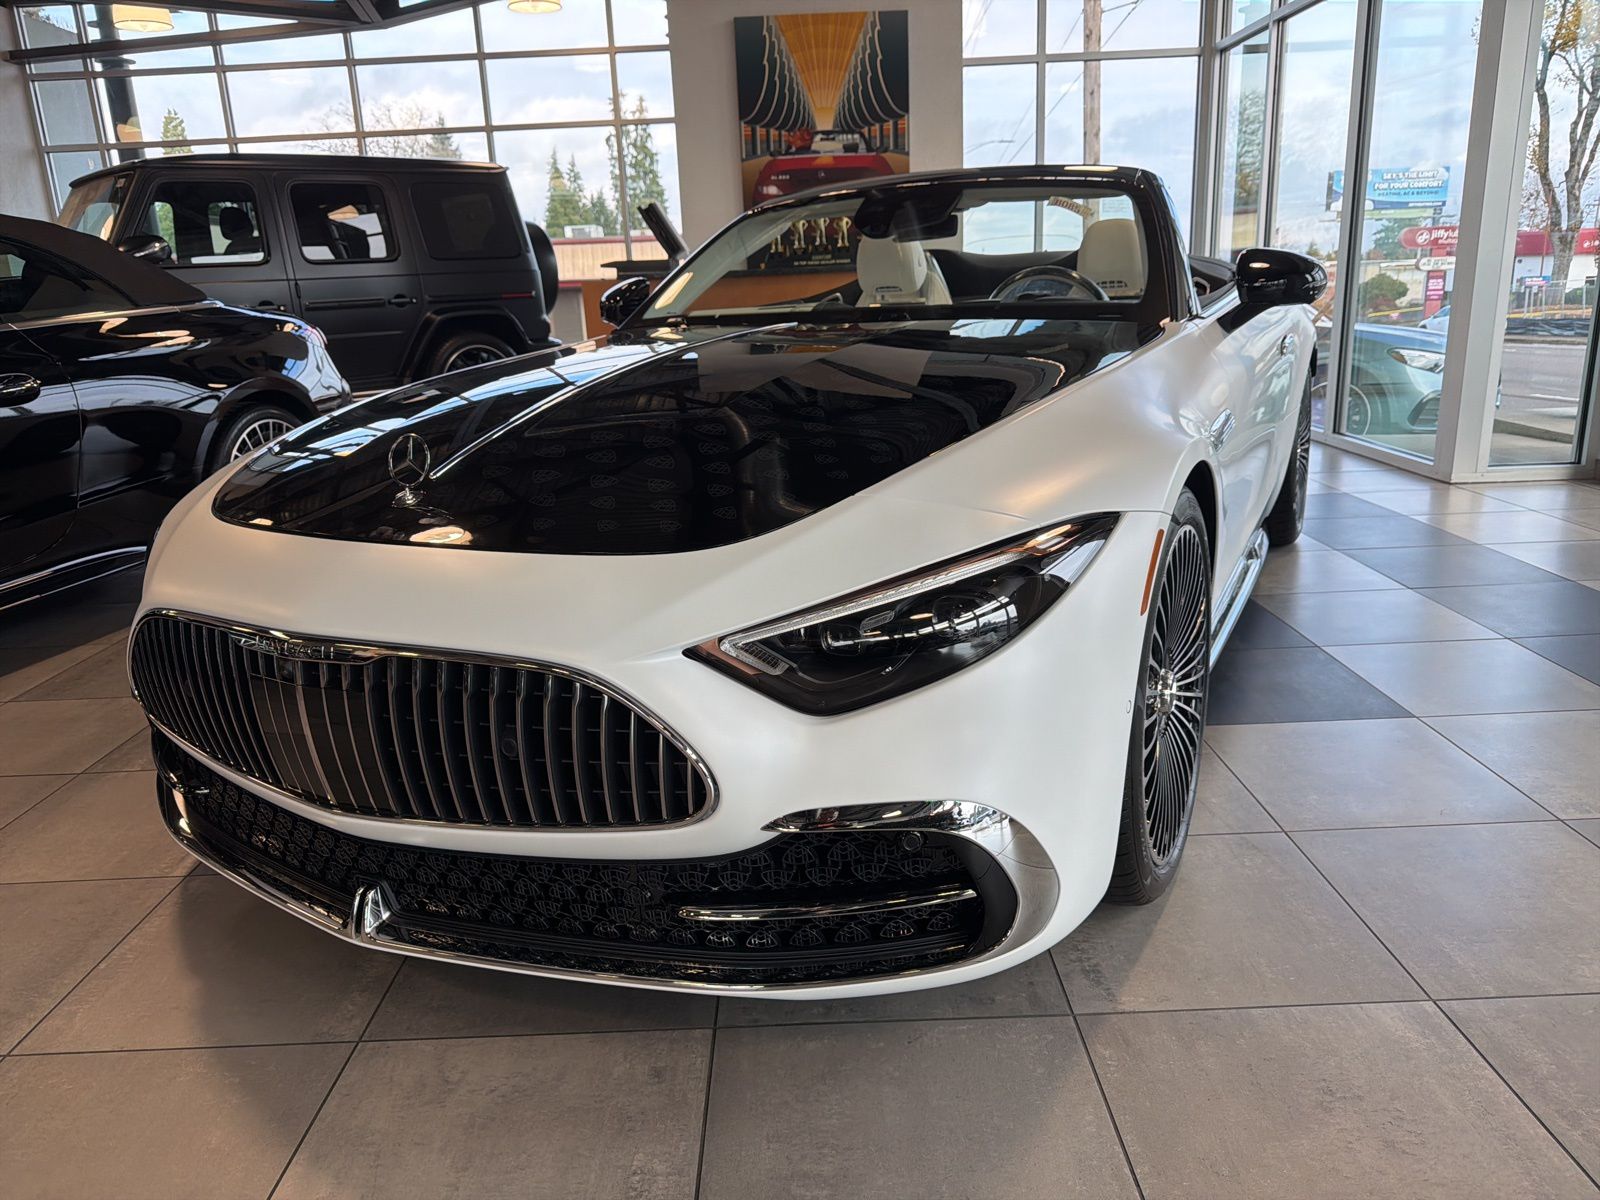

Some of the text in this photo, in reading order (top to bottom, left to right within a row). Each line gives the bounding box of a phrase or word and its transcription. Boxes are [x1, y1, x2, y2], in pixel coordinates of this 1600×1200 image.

[1405, 171, 1418, 179] THE
[1419, 170, 1439, 178] LIMIT
[1390, 182, 1408, 190] YOUR
